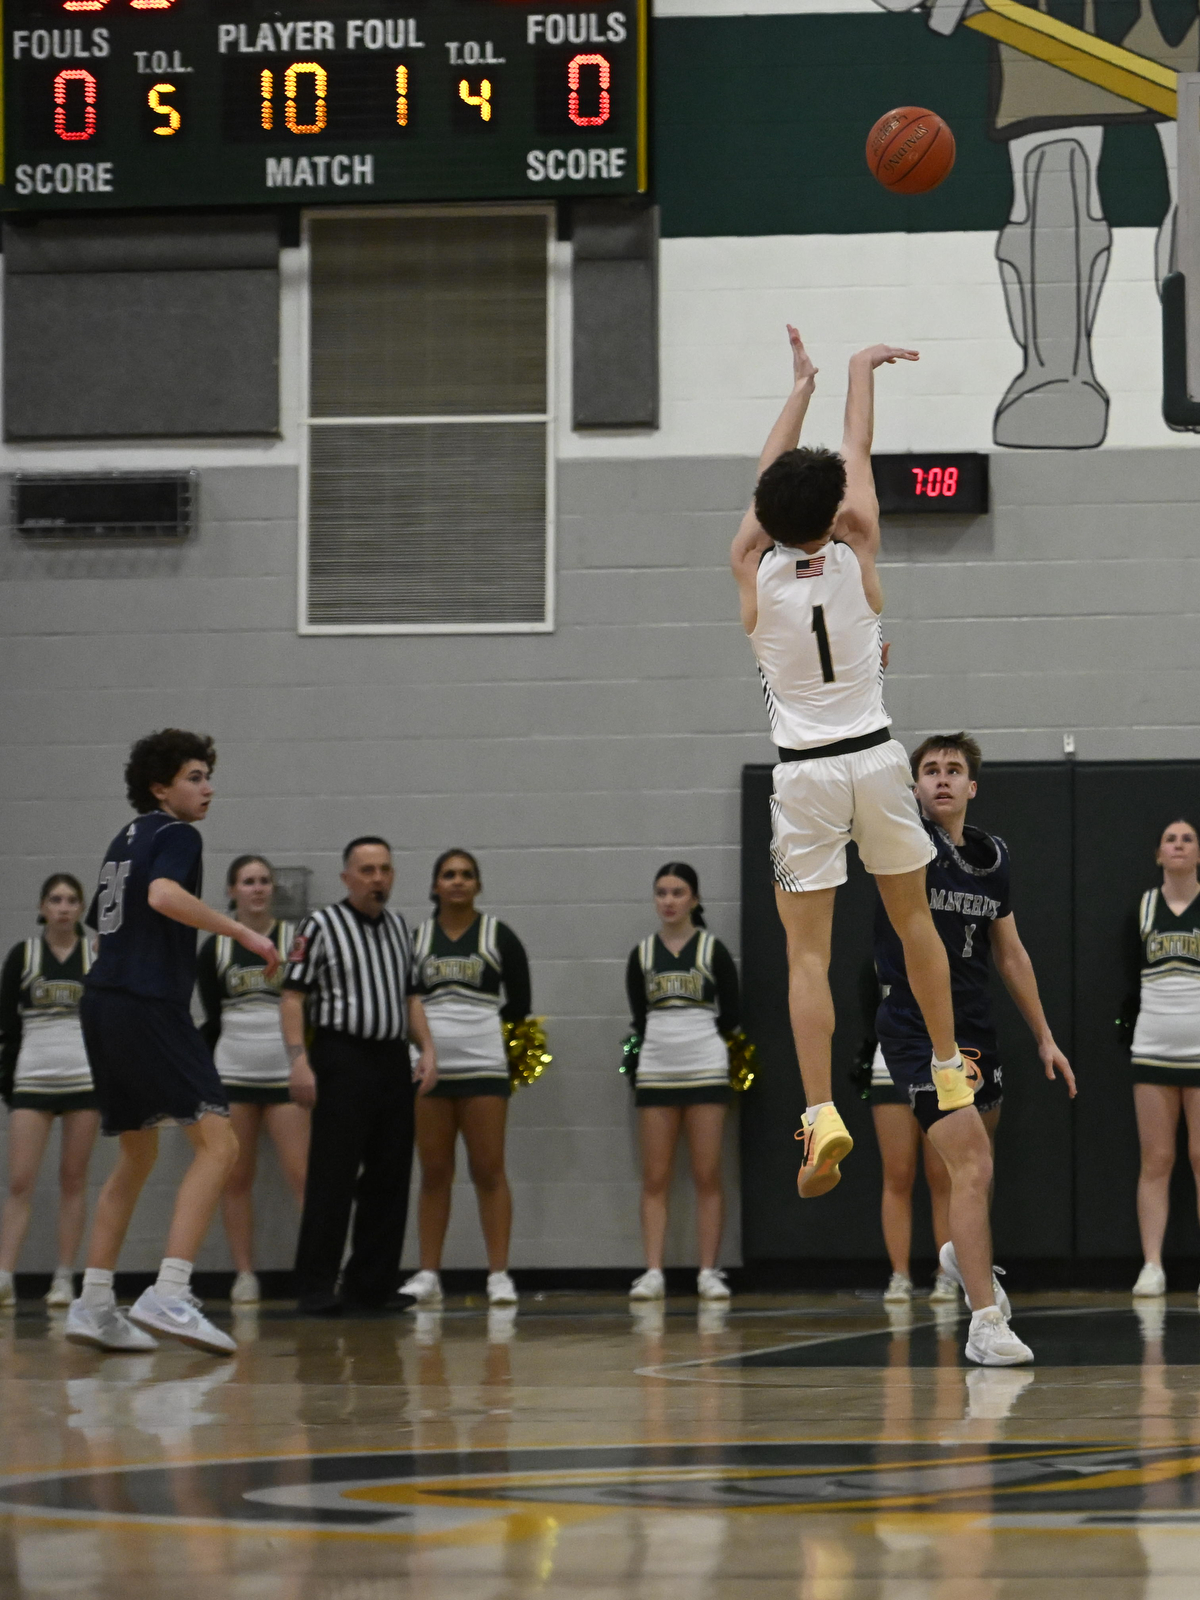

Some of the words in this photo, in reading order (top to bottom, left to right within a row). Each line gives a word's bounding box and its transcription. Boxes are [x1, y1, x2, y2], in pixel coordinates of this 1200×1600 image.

[13, 28, 110, 60] FOULS
[218, 22, 336, 53] PLAYER
[346, 18, 425, 50] FOUL
[526, 12, 627, 45] FOULS
[133, 50, 194, 73] T.O.L.
[444, 41, 507, 65] T.O.L.
[54, 69, 97, 140] 0
[261, 62, 327, 134] 10
[396, 64, 408, 127] 1
[458, 79, 492, 122] 4
[568, 54, 610, 126] 0
[148, 83, 181, 136] 5
[526, 148, 627, 181] SCORE
[884, 123, 929, 175] SPALDING
[15, 162, 113, 194] SCORE
[265, 154, 374, 187] MATCH
[911, 466, 959, 497] 7:08
[811, 603, 836, 683] 1
